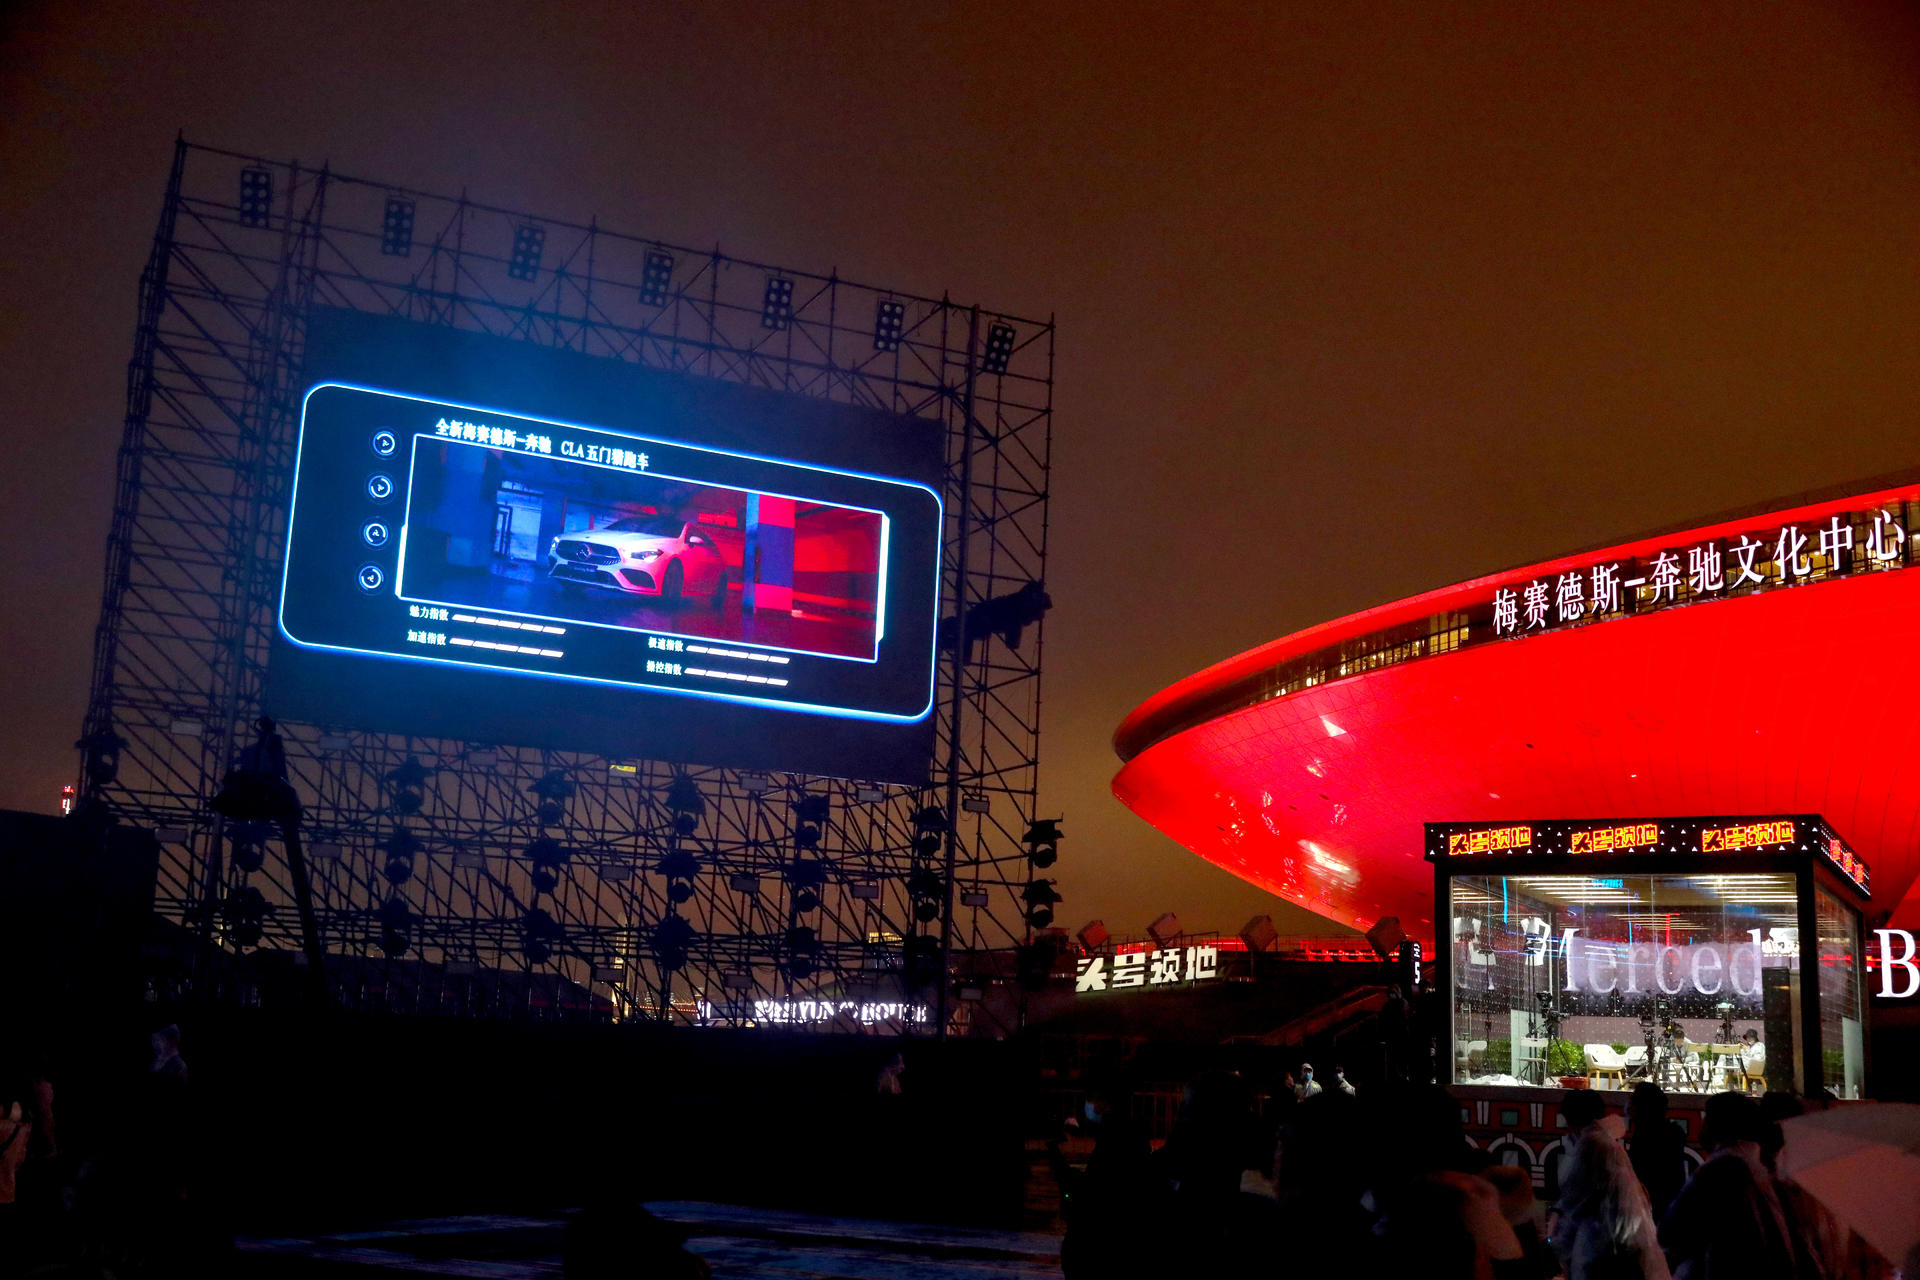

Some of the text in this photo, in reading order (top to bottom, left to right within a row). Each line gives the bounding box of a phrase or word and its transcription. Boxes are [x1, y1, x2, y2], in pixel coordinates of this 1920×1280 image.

[1492, 510, 1906, 635] 梅赛德斯-奔驰文化中心
[1448, 826, 1532, 855] 头号领地
[1570, 823, 1659, 855] 头号领地
[1701, 820, 1795, 853] 头号领地
[1075, 944, 1218, 993] 头号领地
